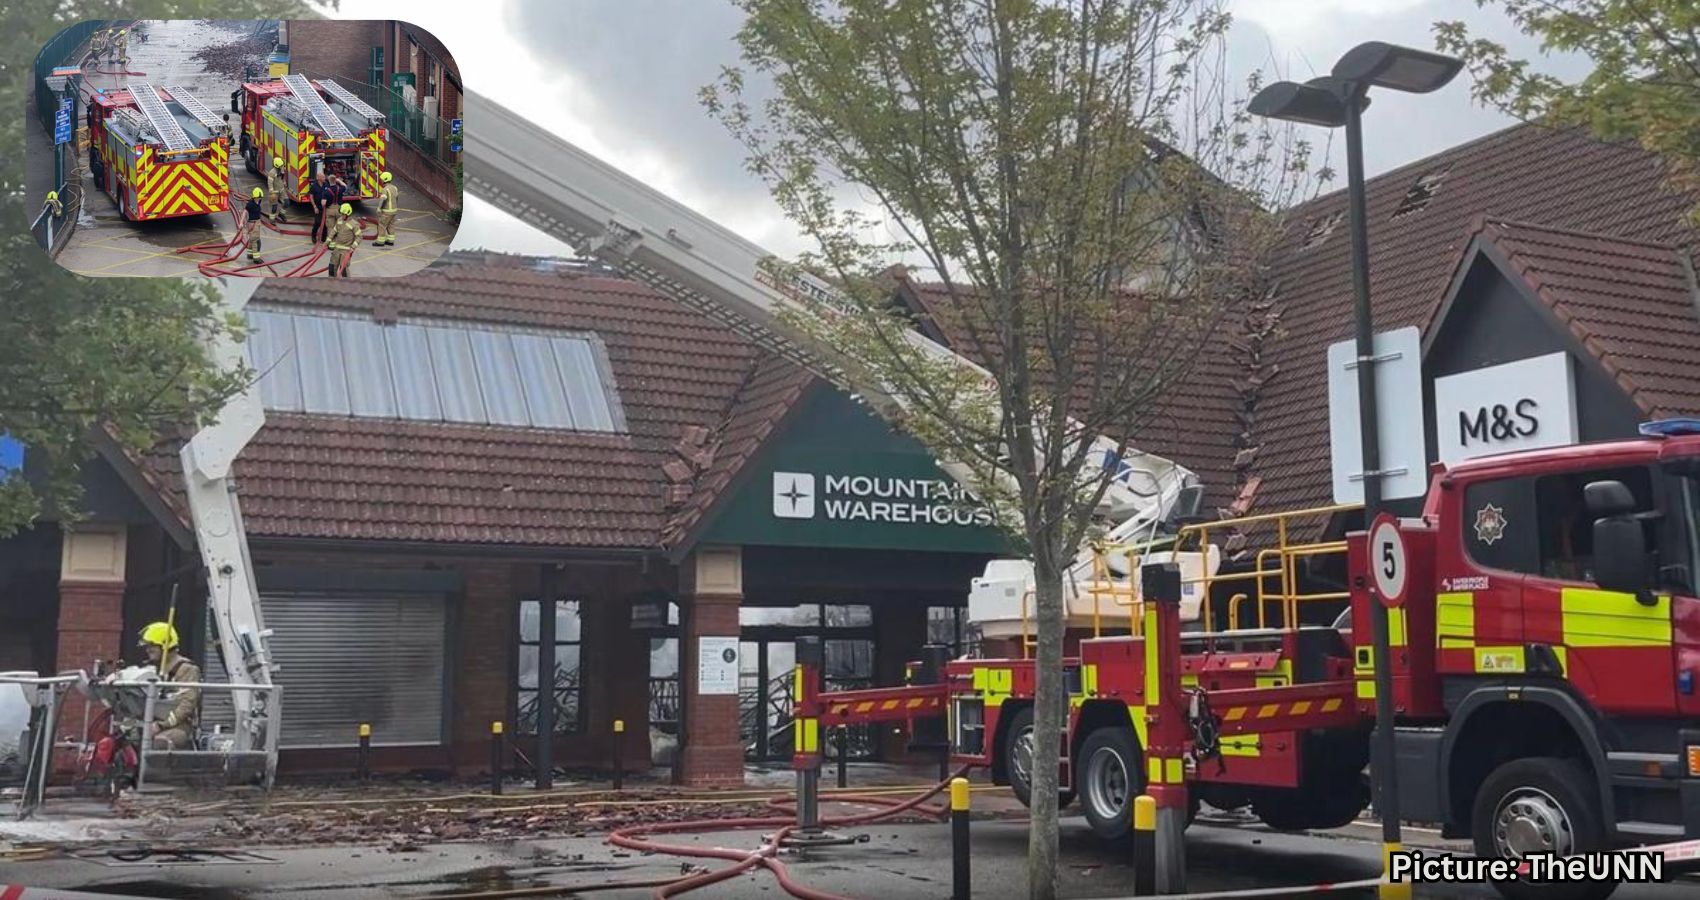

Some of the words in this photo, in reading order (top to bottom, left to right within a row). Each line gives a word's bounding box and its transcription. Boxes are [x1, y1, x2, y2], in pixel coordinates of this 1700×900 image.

[1458, 398, 1540, 447] M&S
[824, 500, 997, 527] WAREHOUS
[1381, 542, 1395, 580] 5
